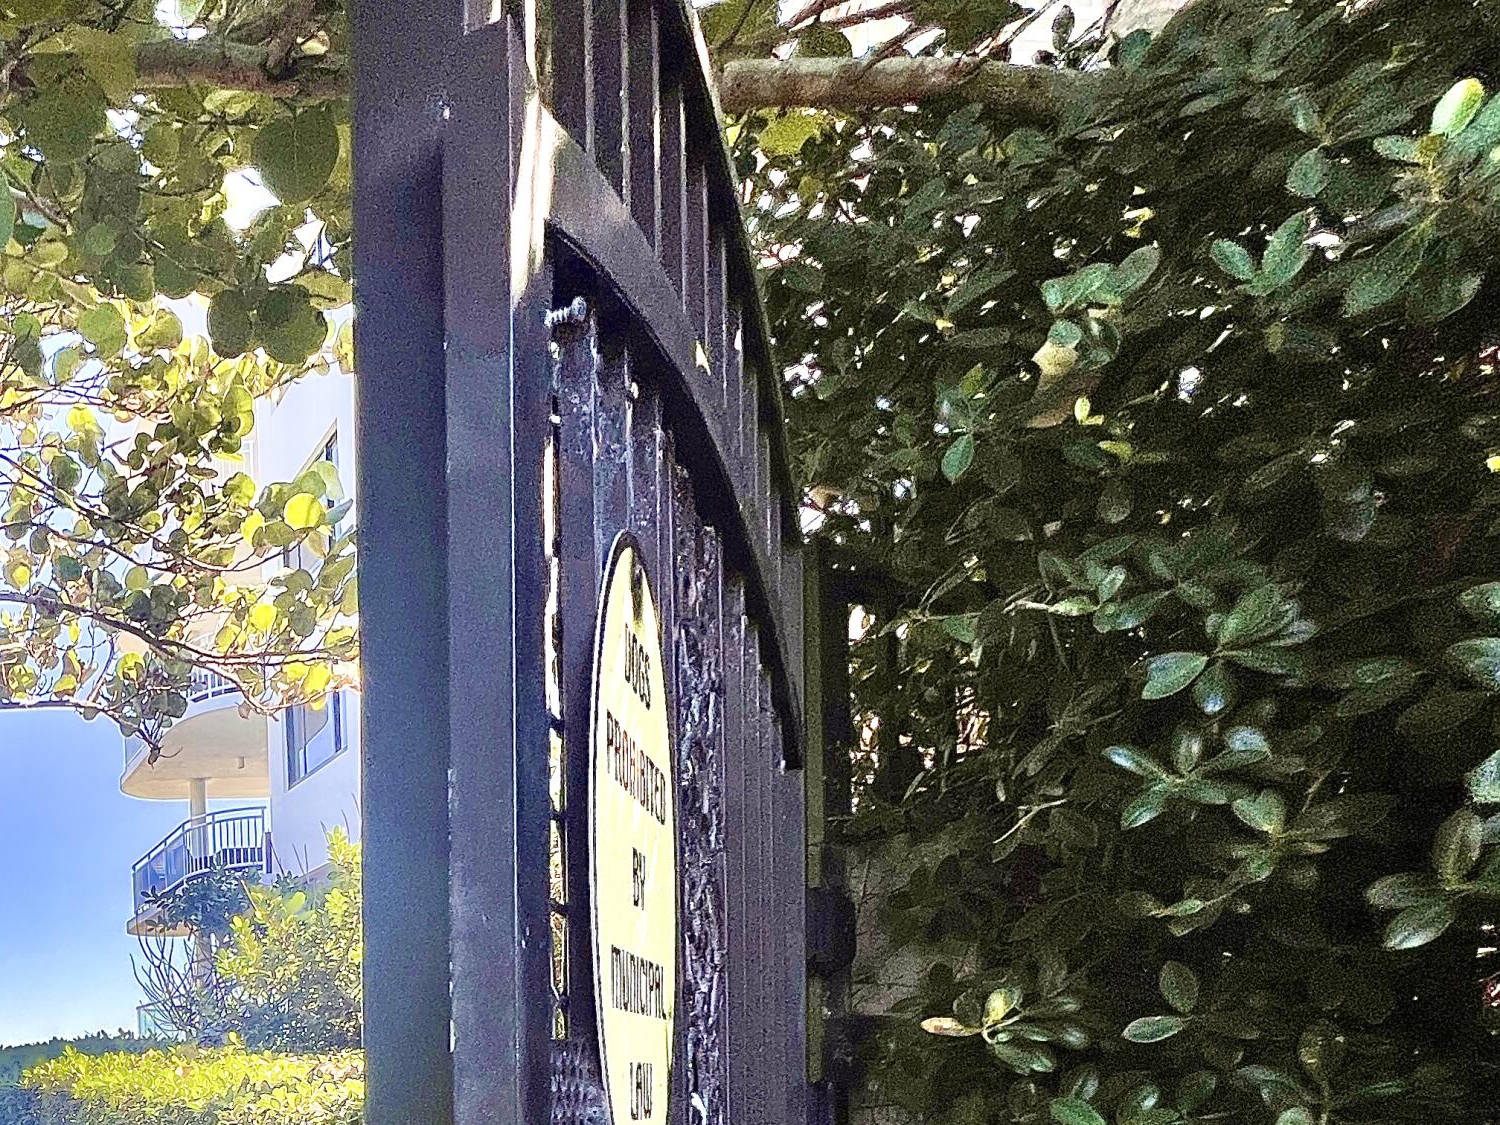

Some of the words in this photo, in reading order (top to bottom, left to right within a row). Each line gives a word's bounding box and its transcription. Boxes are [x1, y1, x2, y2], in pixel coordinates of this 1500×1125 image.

[624, 622, 651, 711] DOGS
[606, 708, 666, 826] PROHIBITED
[632, 846, 646, 911] BY
[611, 943, 667, 1020] MUNICIPAL
[630, 1061, 653, 1121] LAW
